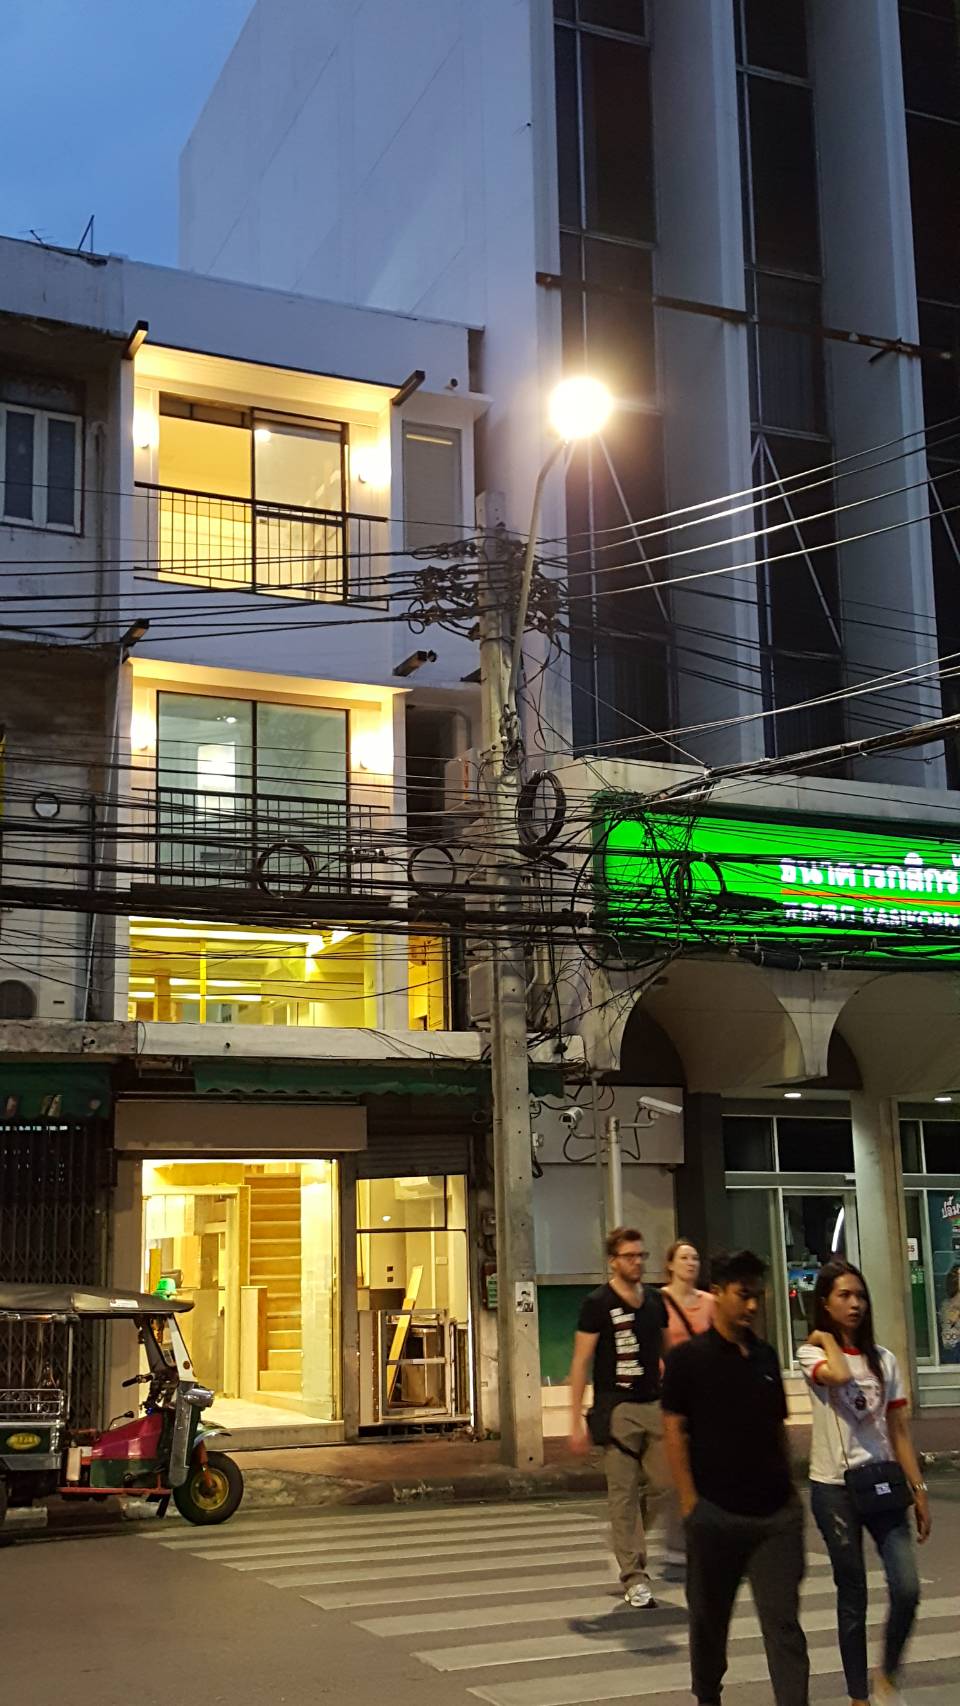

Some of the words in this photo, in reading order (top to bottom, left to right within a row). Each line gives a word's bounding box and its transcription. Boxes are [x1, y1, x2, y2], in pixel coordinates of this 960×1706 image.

[780, 852, 960, 894] ธนาคารกสิกร
